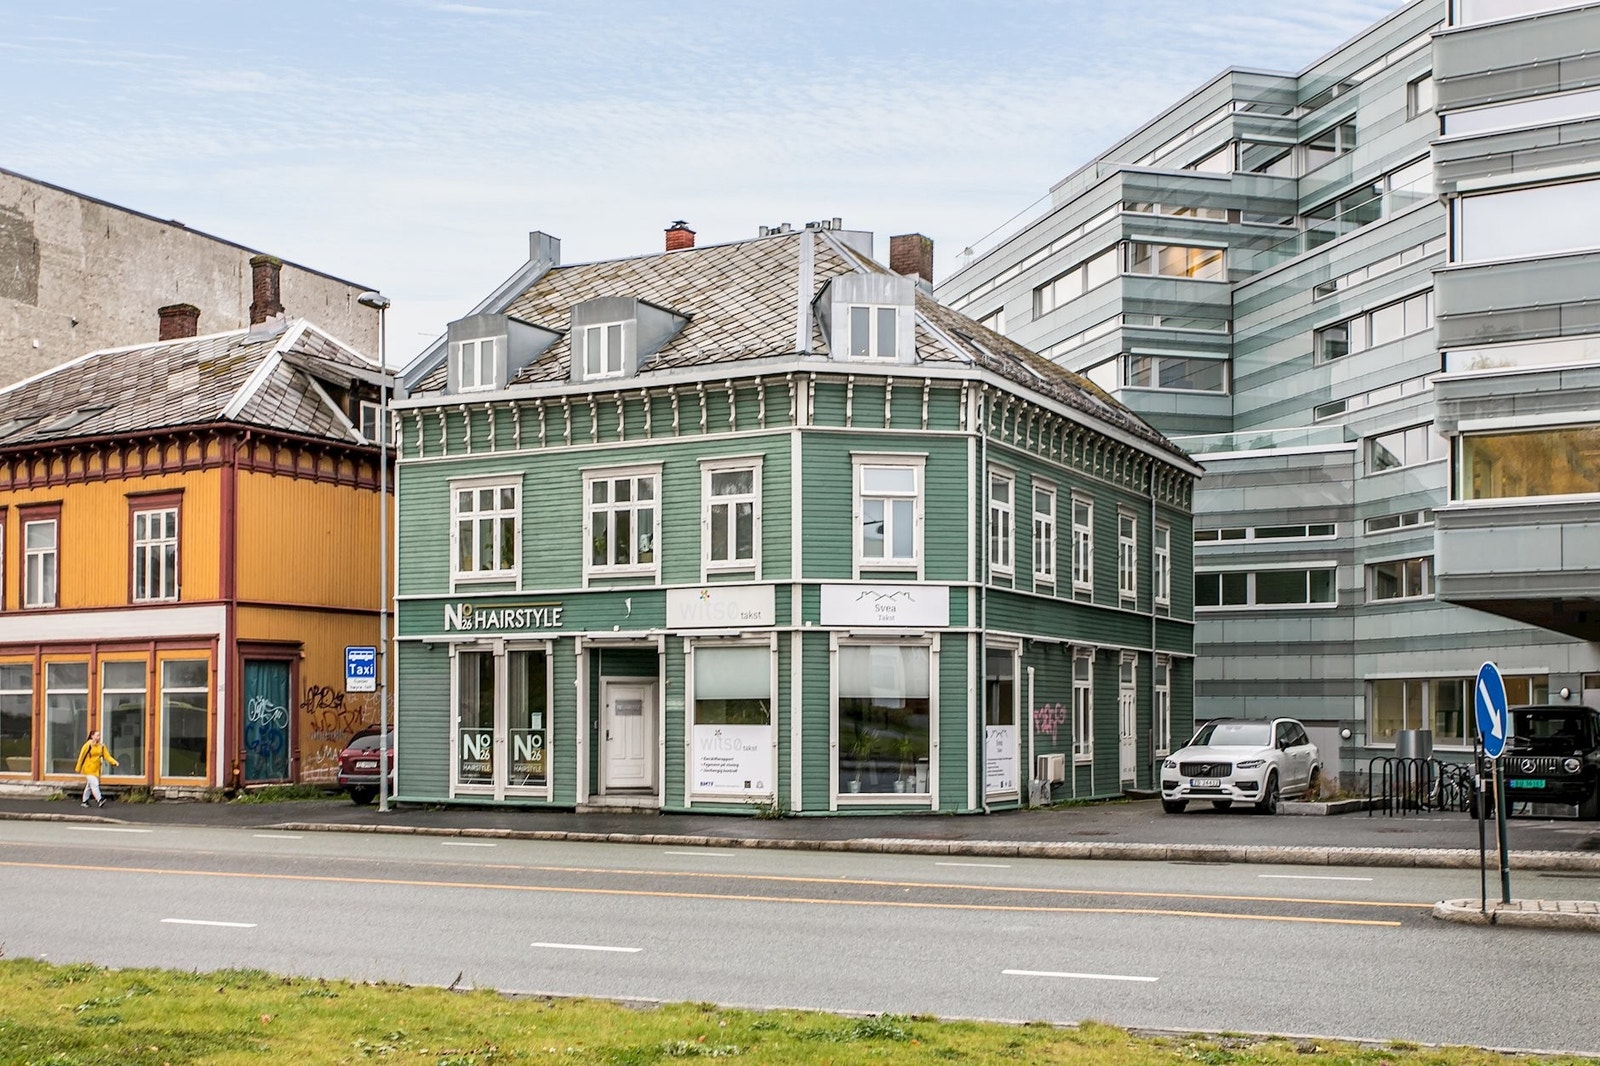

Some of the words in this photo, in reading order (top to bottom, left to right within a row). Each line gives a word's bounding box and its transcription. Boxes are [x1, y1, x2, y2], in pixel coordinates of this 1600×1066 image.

[875, 603, 896, 612] Svea
[474, 607, 563, 630] HAIRSTYLE
[741, 609, 761, 620] takst
[461, 619, 472, 631] 26
[349, 663, 374, 675] Taxi
[480, 749, 491, 760] 26
[531, 750, 542, 761] 26
